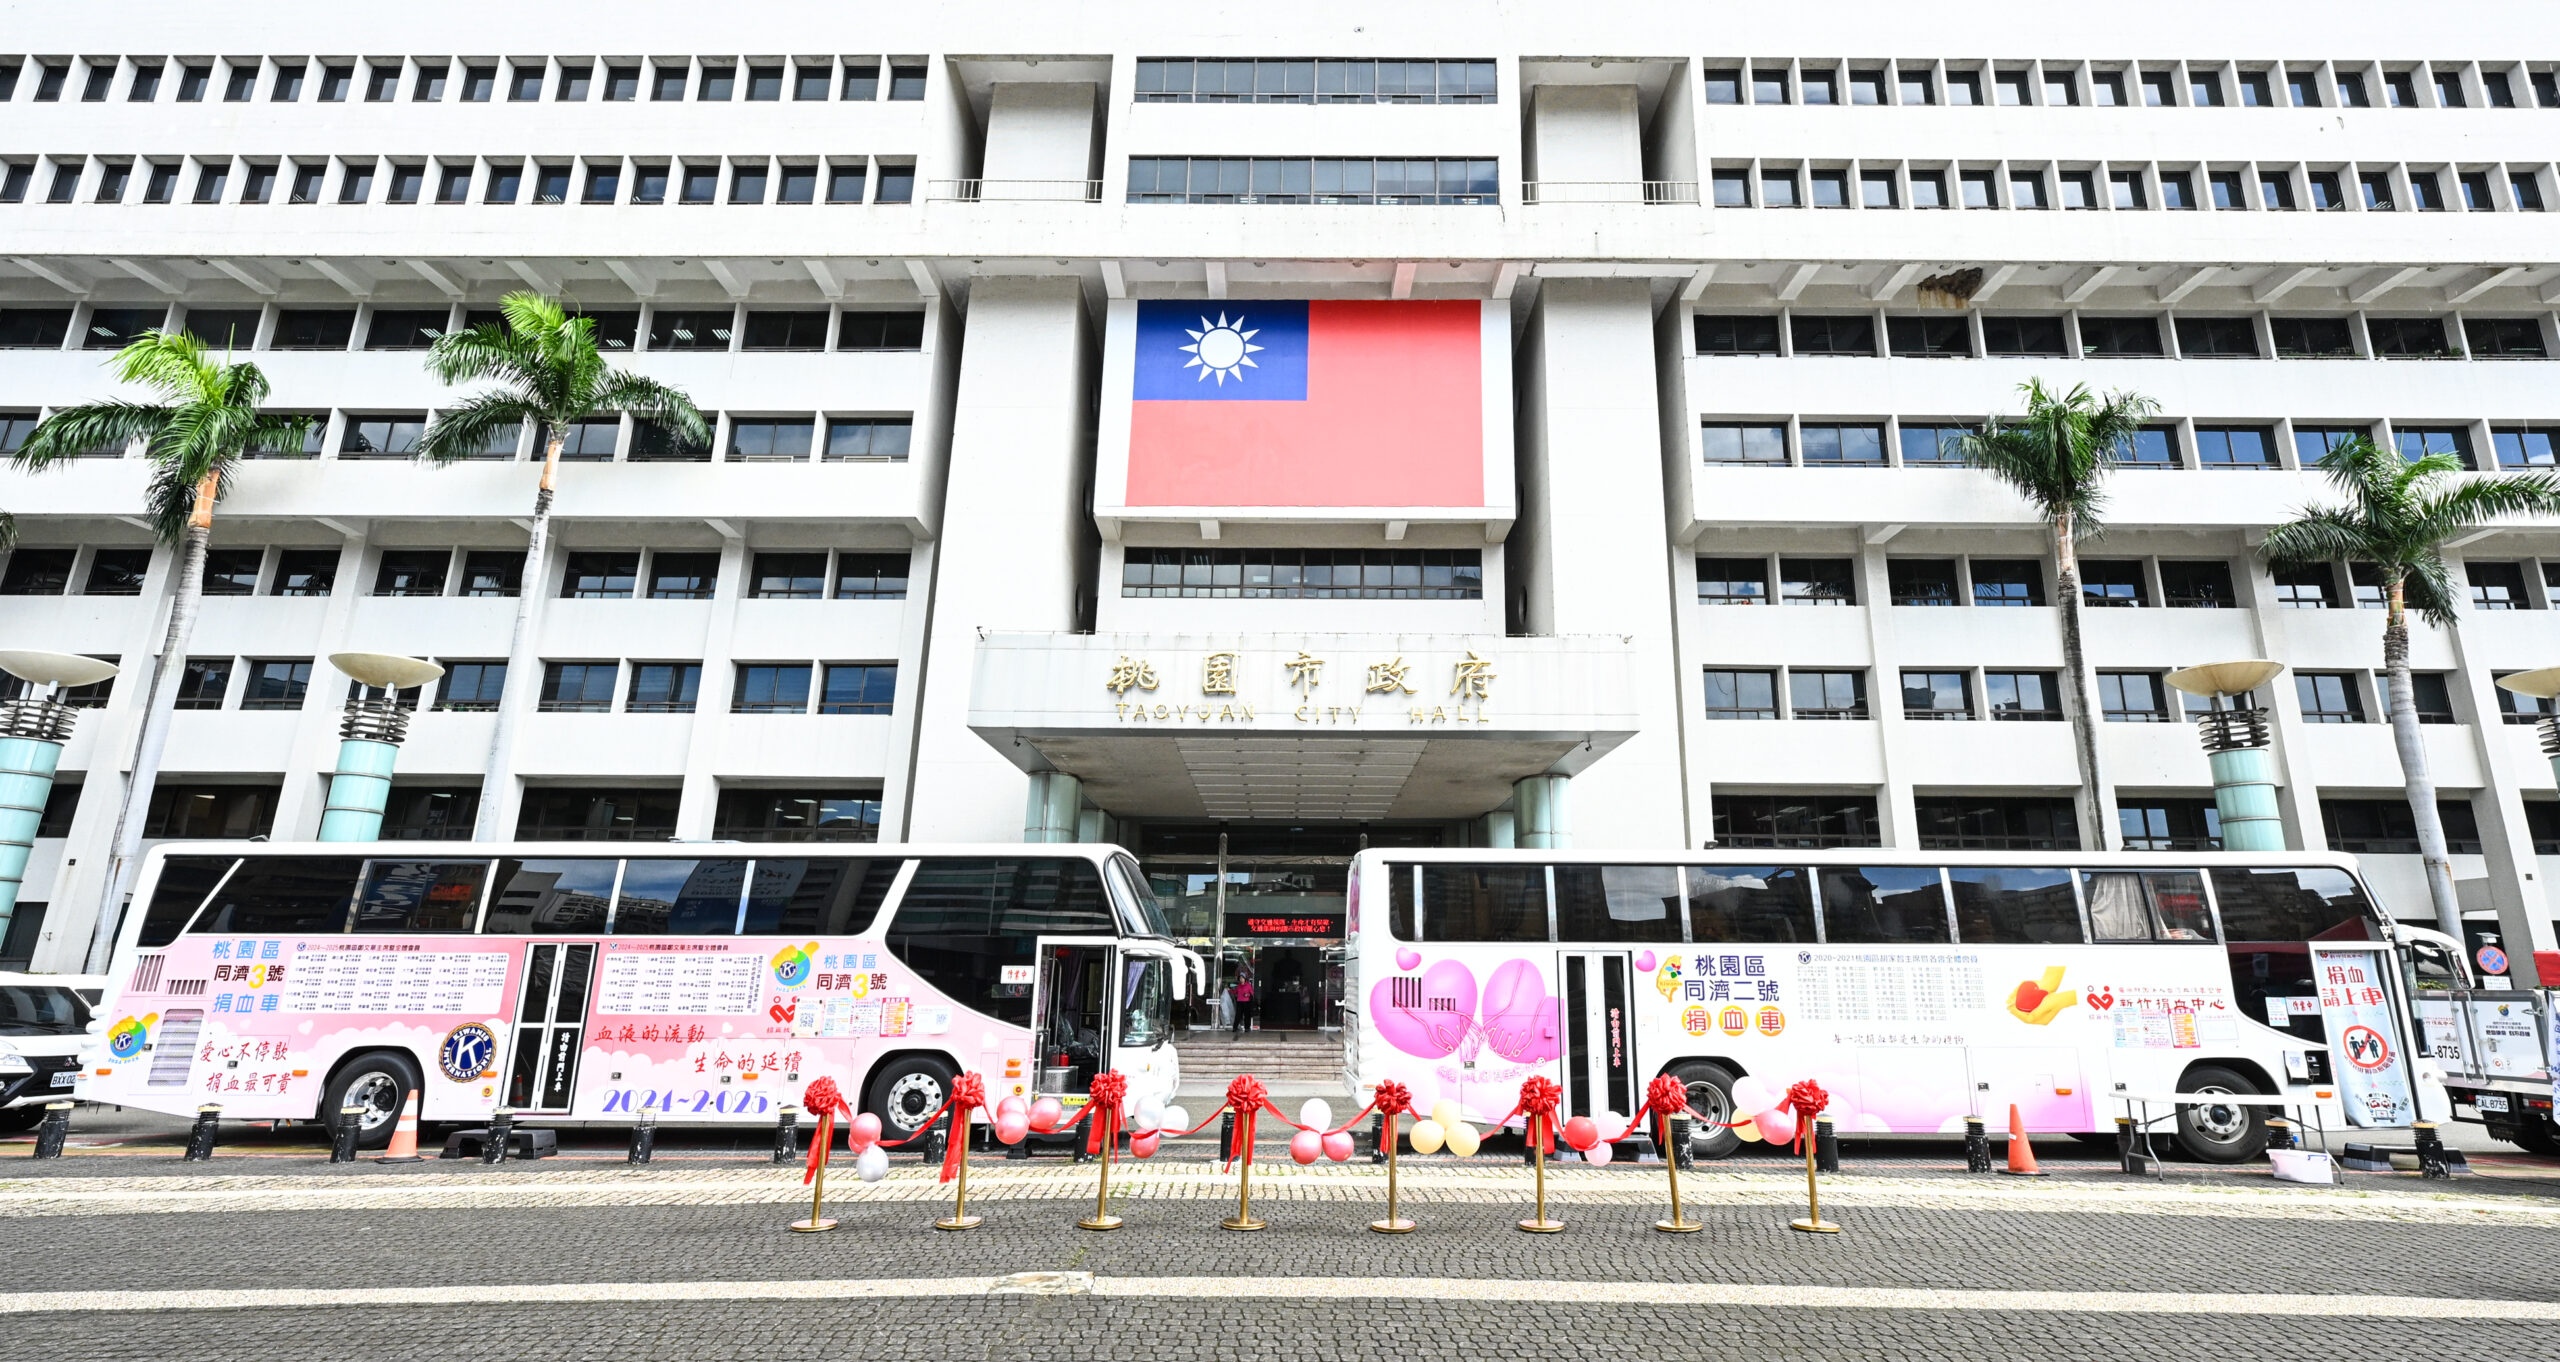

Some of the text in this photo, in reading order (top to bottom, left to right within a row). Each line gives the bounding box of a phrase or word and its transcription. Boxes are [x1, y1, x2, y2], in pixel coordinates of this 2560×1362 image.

[1106, 651, 1497, 702] 桃園市政府
[1114, 702, 1488, 724] TAOYUAN CITY HALL
[213, 940, 281, 960] 桃園區
[823, 954, 877, 969] 桃園區
[1695, 955, 1766, 976] 桃園區
[214, 964, 286, 989] 同濟3號
[816, 973, 888, 999] 同濟3號
[2327, 966, 2365, 984] 捐血
[1684, 980, 1780, 1002] 同濟二號
[2321, 987, 2385, 1007] 請上車
[213, 993, 280, 1013] 捐血車
[1685, 1009, 1781, 1032] 捐血車
[452, 1026, 490, 1042] KIWANIS
[594, 1023, 706, 1043] 血液的流動
[1609, 1007, 1621, 1068] 請由前門上車
[201, 1041, 289, 1062] 愛心不停歇
[443, 1046, 492, 1079] INTERNATIONAL
[554, 1032, 571, 1093] 請由前門上車
[694, 1051, 803, 1073] 生命的延續
[206, 1073, 291, 1095] 捐血最可貴
[602, 1089, 769, 1114] 2024~2025
